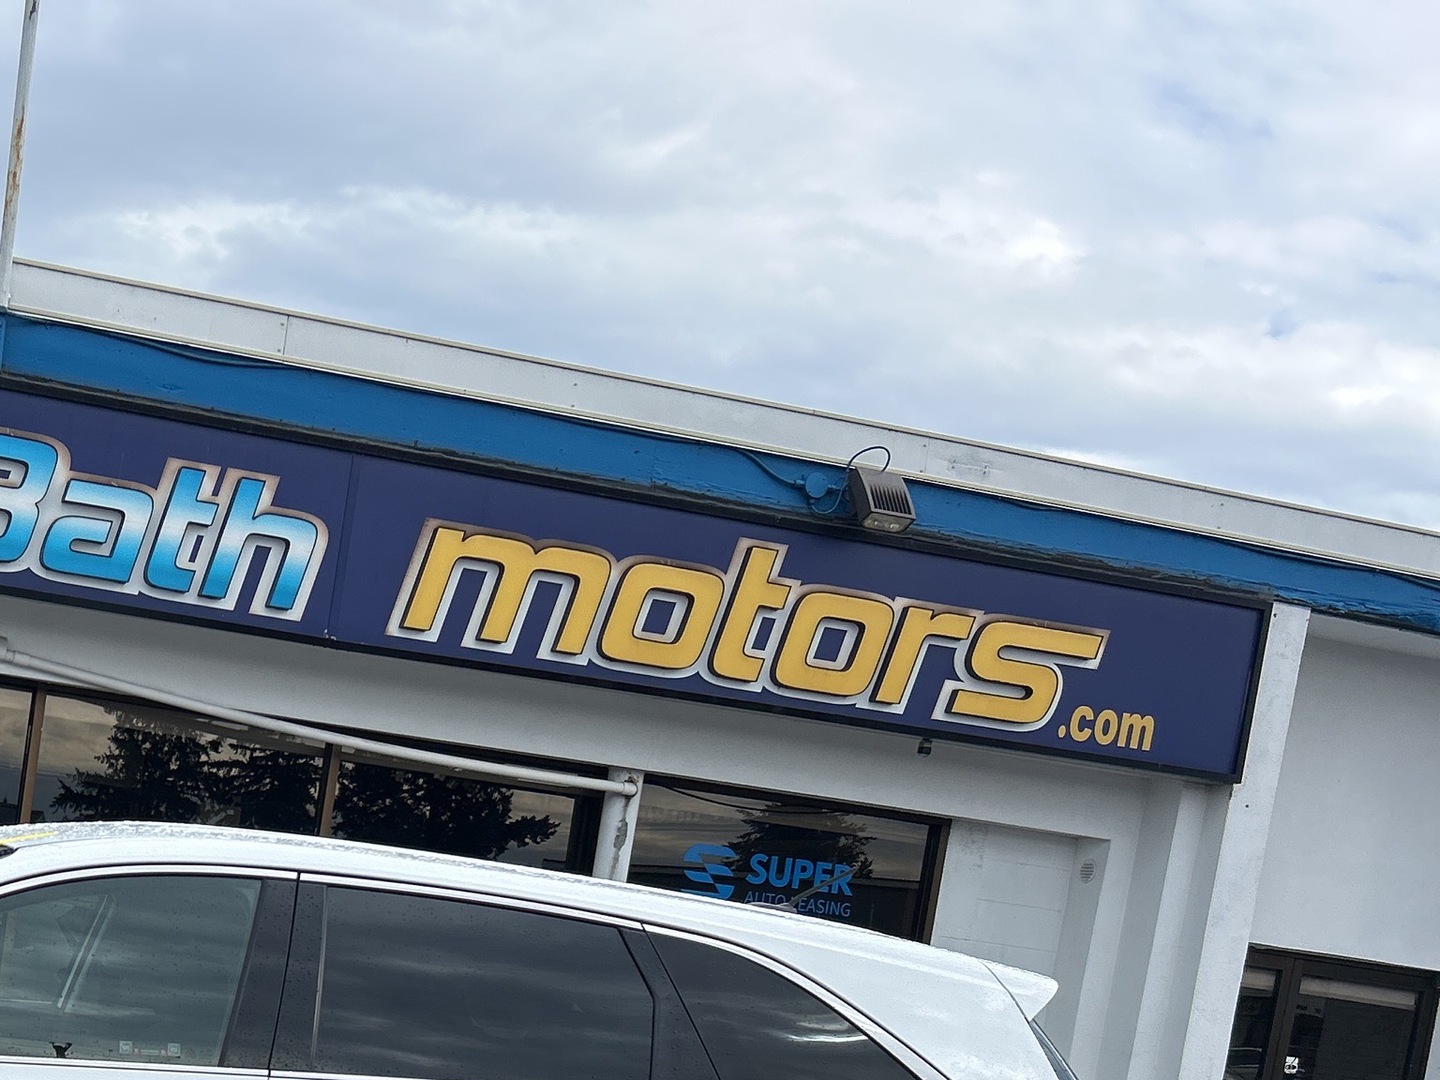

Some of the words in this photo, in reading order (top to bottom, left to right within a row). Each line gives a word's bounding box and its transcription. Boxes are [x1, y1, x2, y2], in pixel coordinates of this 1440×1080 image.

[385, 517, 1111, 732] motors
[1058, 705, 1155, 751] .com
[745, 853, 854, 896] SUPER
[791, 896, 852, 917] EASING
